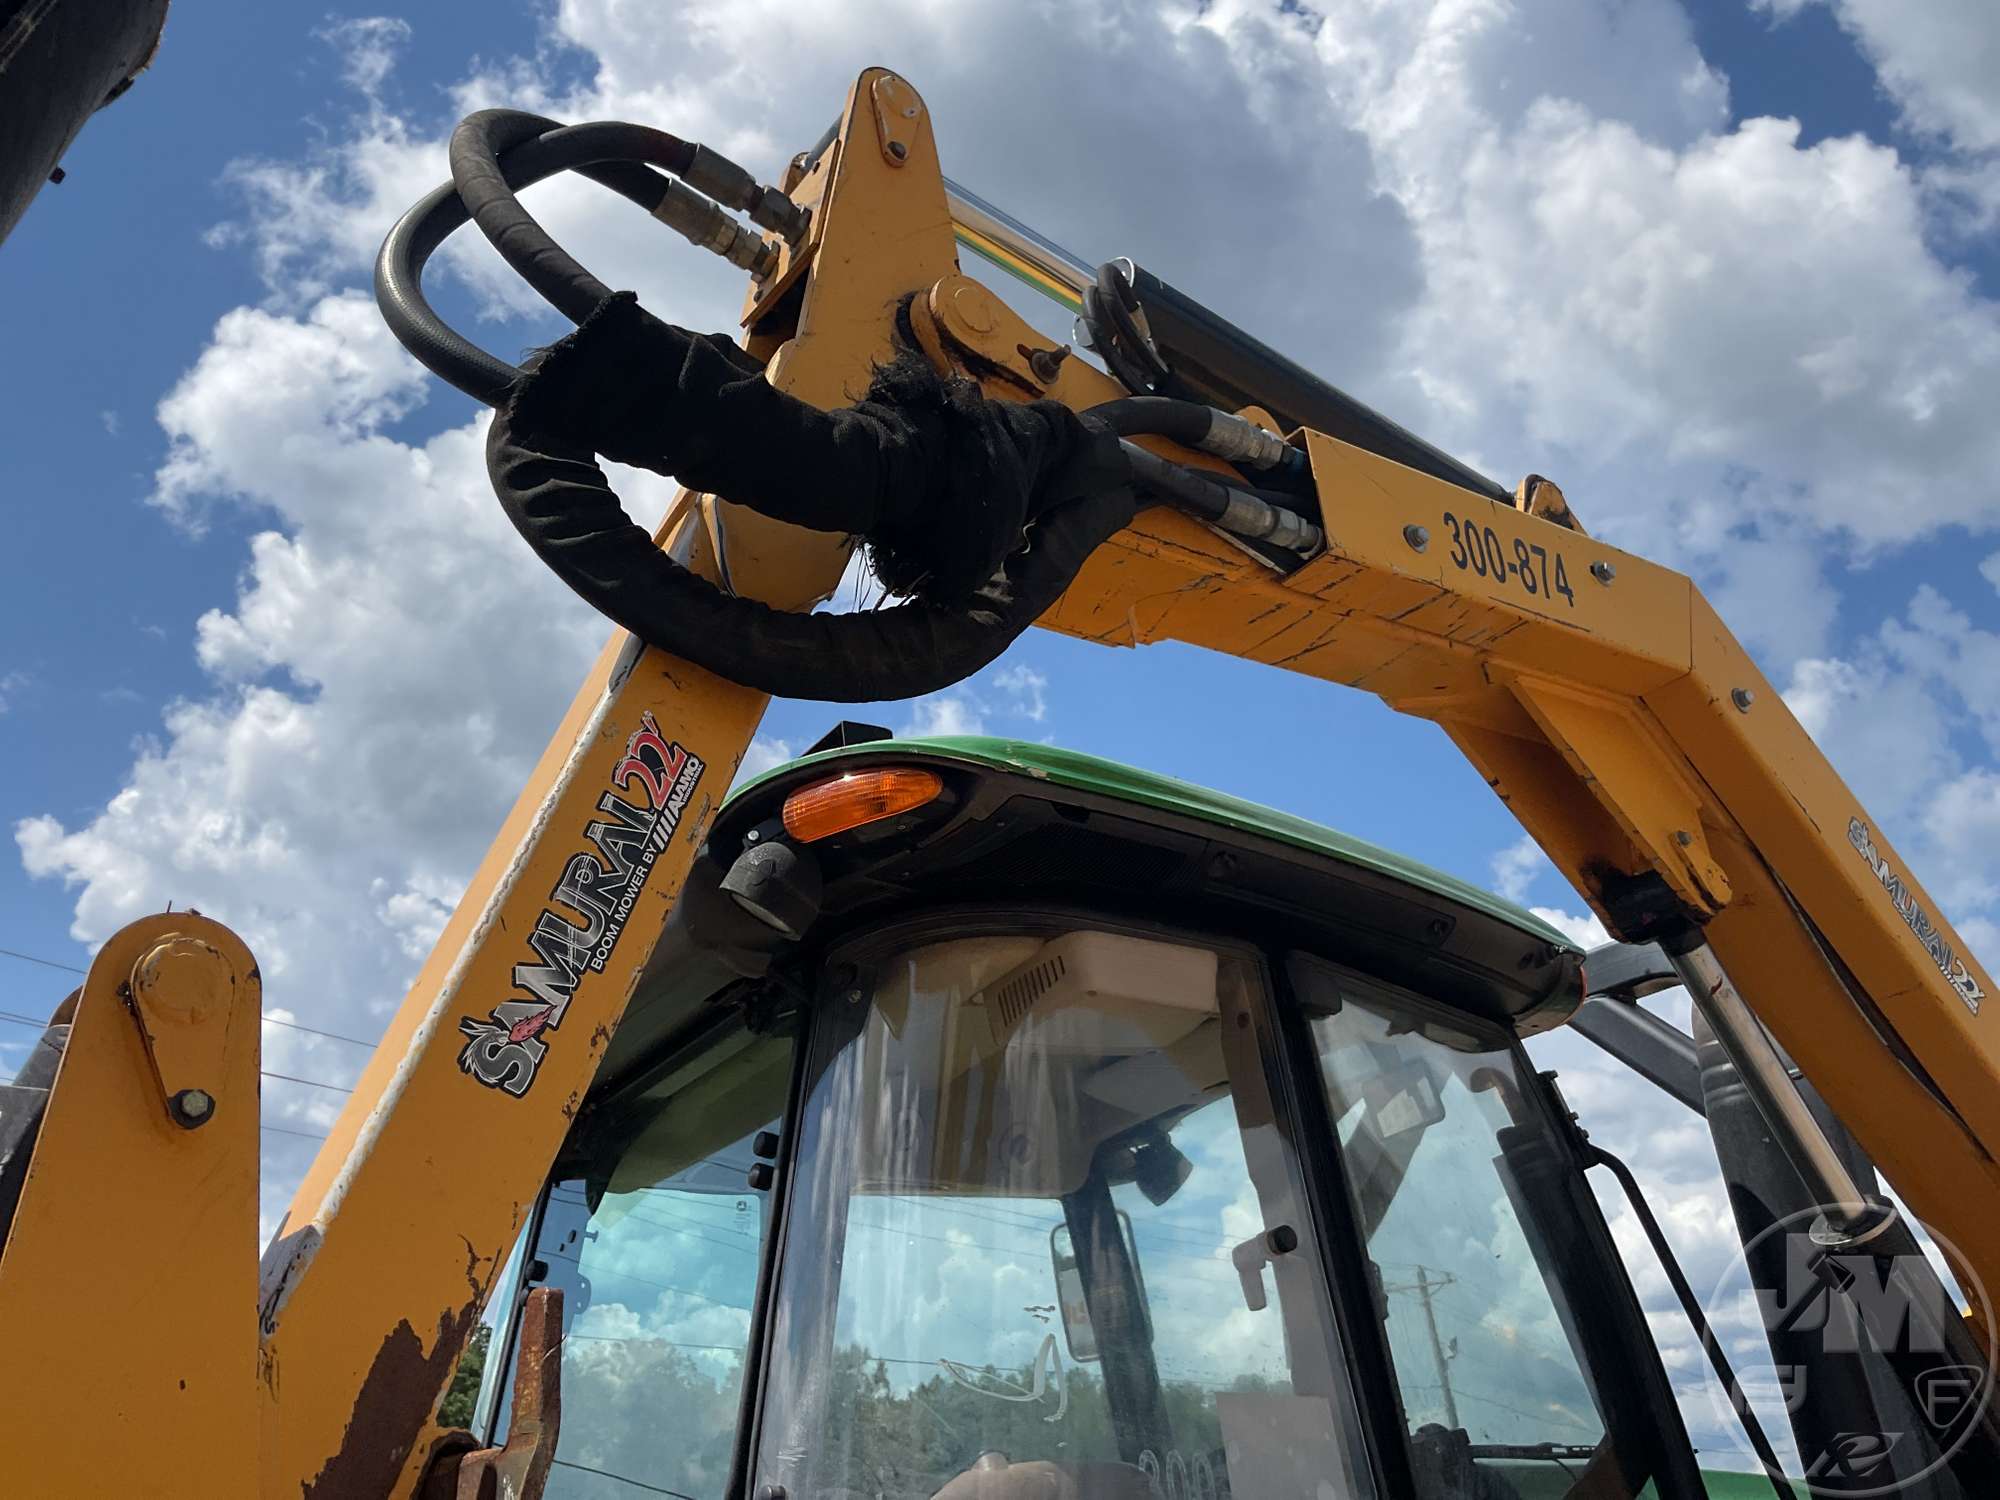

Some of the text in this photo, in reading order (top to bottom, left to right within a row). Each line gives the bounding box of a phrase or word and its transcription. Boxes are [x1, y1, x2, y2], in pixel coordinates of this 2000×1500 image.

[1443, 511, 1574, 608] 300-874
[460, 722, 688, 1096] SAMURAI 22
[591, 928, 620, 971] BOOM
[614, 865, 648, 923] MOWER
[642, 843, 657, 864] BY
[1848, 816, 1954, 977] SAMURAI
